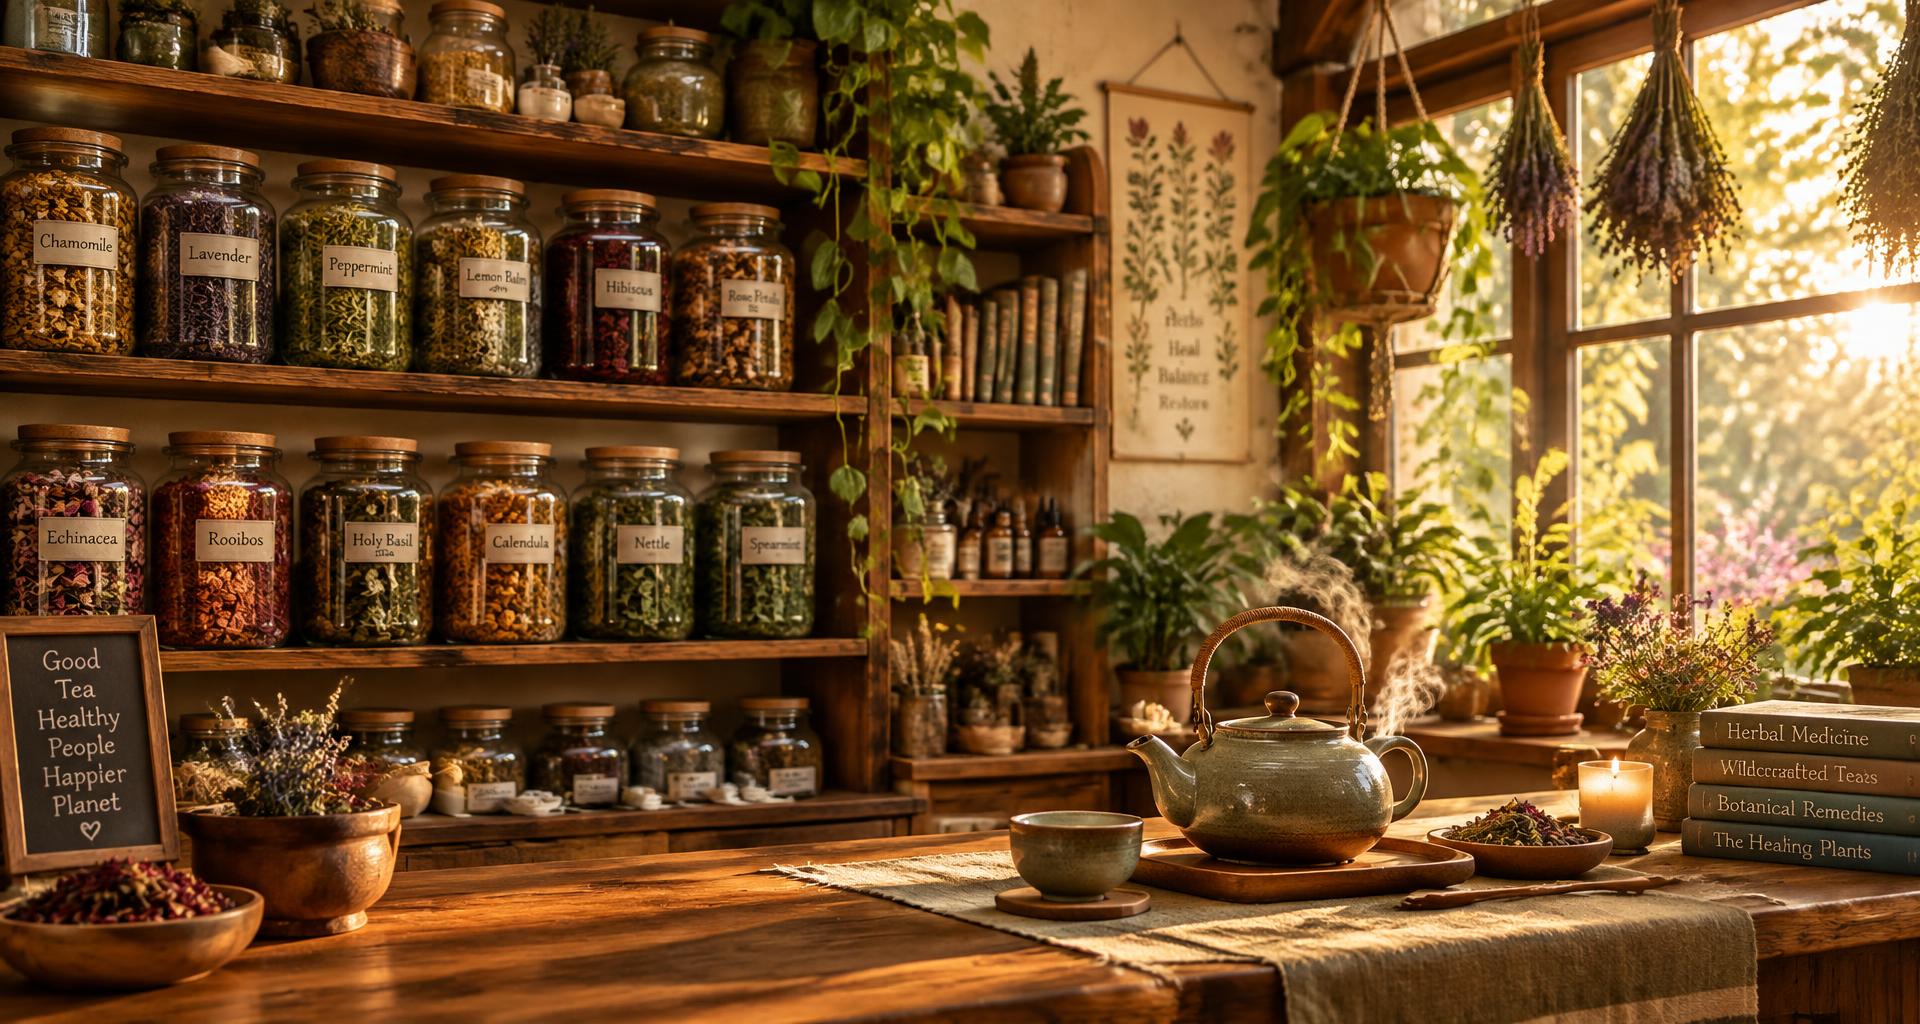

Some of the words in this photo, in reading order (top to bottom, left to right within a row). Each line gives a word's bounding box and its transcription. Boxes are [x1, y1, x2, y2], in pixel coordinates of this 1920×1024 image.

[40, 233, 113, 253] Chamomile
[189, 245, 252, 264] Lavender
[329, 257, 393, 277] Peppermint
[466, 268, 502, 282] Lemon
[606, 280, 653, 297] Hibiscus
[47, 530, 118, 546] Echinacea
[208, 531, 264, 547] Rooibos
[353, 533, 382, 549] Holy
[386, 533, 413, 547] Basil
[492, 535, 550, 550] Calendula
[634, 536, 670, 551] Nettle
[43, 648, 101, 671] Good
[54, 679, 96, 699] Tea
[38, 707, 120, 732] Healthy
[1727, 722, 1785, 742] Herbal
[48, 734, 116, 762] People
[43, 763, 127, 791] Happier
[53, 793, 121, 817] Planet
[1717, 794, 1796, 816] Botanical
[1803, 801, 1884, 823] Remedies
[1713, 832, 1743, 849] The
[1749, 834, 1812, 860] Healing
[1819, 839, 1872, 860] Plants
